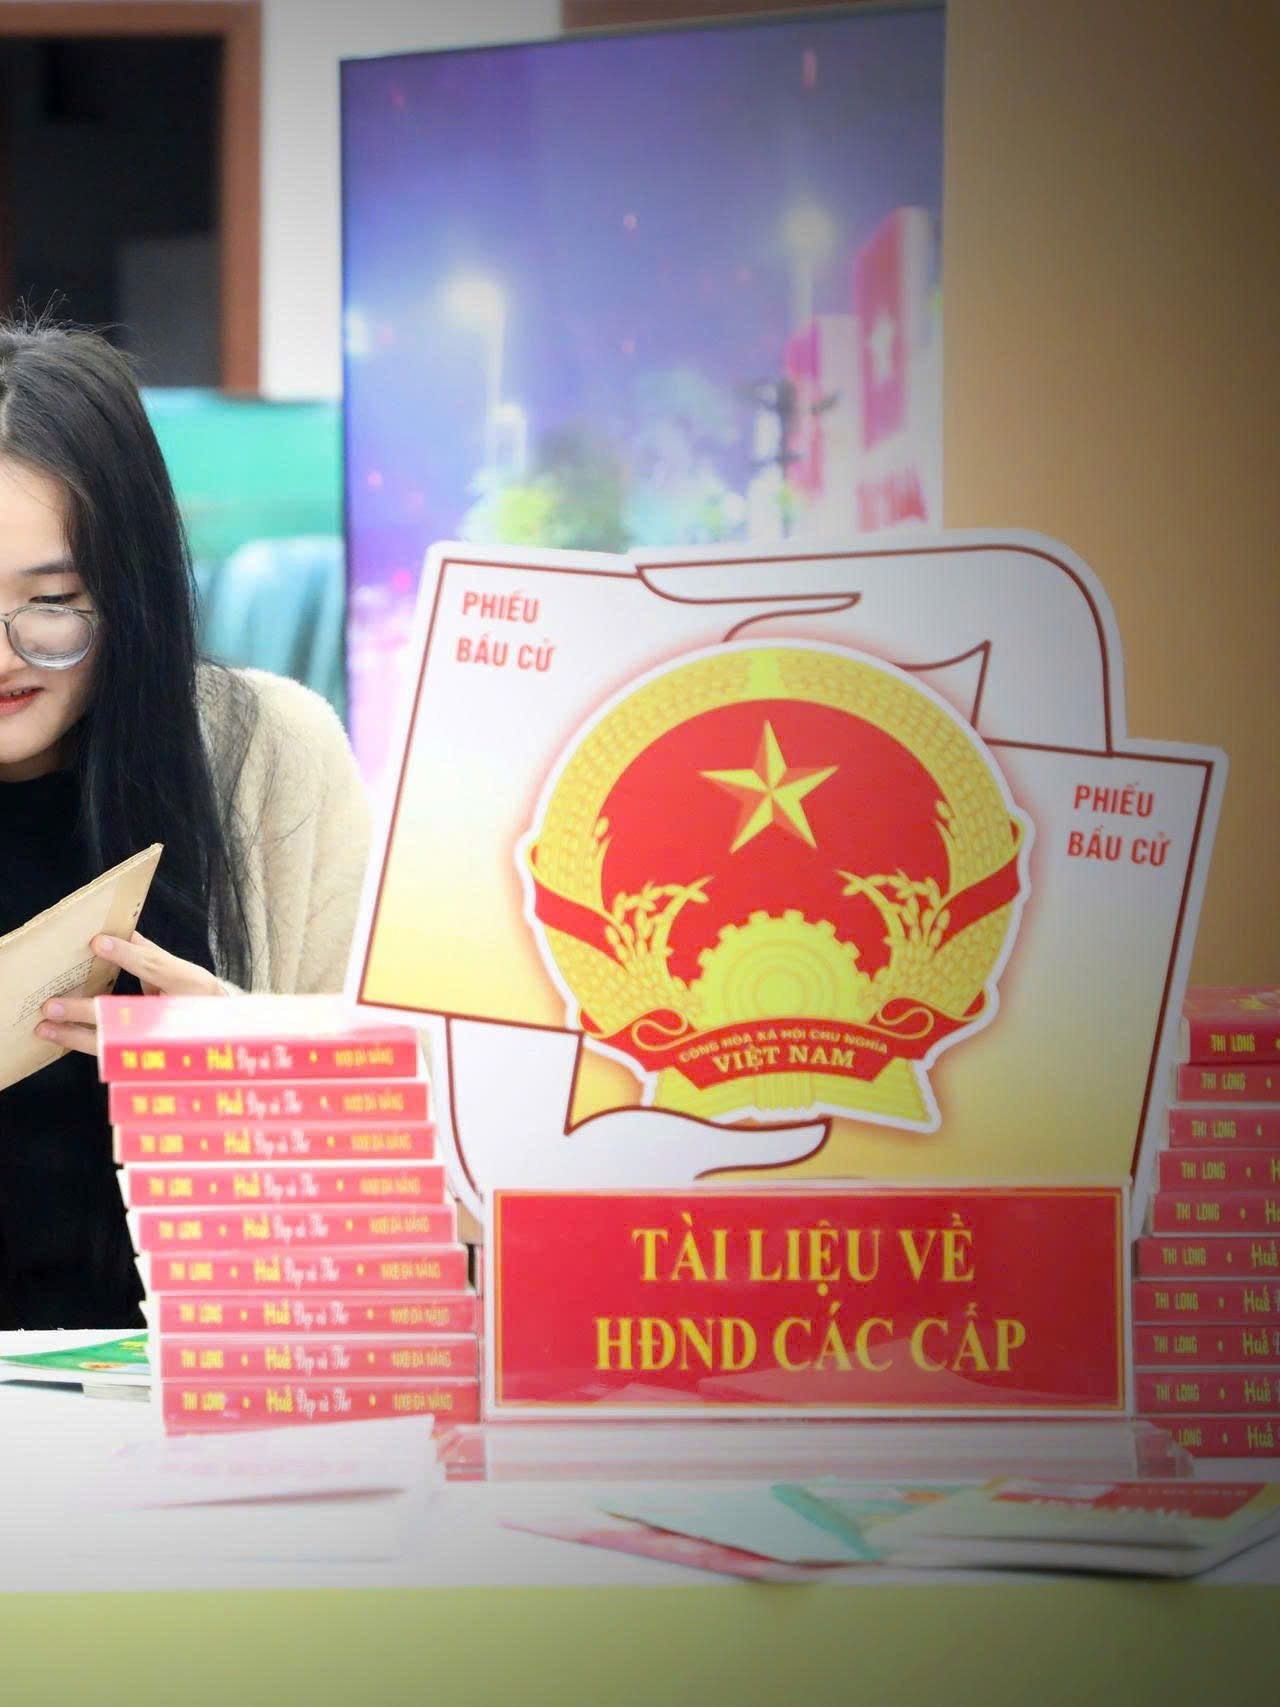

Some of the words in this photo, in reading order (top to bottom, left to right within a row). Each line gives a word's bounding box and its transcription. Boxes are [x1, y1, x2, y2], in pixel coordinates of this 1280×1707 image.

[462, 588, 539, 624] PHIẾU
[518, 637, 556, 672] CỬ
[1073, 781, 1154, 818] PHIẾU
[1131, 831, 1171, 867] CỬ
[1211, 1034, 1225, 1051] THI
[1231, 1034, 1256, 1052] LONG
[712, 1043, 781, 1073] VIỆT
[789, 1045, 855, 1068] NAM
[1201, 1072, 1216, 1089] THI
[1222, 1072, 1246, 1090] LONG
[1192, 1120, 1206, 1137] THI
[1213, 1120, 1236, 1138] LONG
[1181, 1161, 1195, 1178] THI
[1202, 1161, 1226, 1179] LONG
[1176, 1203, 1190, 1220] THI
[1197, 1203, 1220, 1220] LONG
[631, 1212, 728, 1282] TÀI
[747, 1220, 881, 1296] LIỆU
[898, 1212, 975, 1282] VỀ
[1163, 1248, 1177, 1264] THI
[1183, 1248, 1206, 1266] LONG
[1155, 1292, 1169, 1309] THI
[1175, 1292, 1199, 1311] LONG
[594, 1317, 758, 1371] HĐND
[773, 1300, 894, 1371] CÁC
[1153, 1336, 1168, 1353] THI
[1174, 1336, 1197, 1353] LONG
[1156, 1384, 1169, 1401] THI
[1176, 1384, 1199, 1402] LONG
[1178, 1428, 1202, 1446] LONG
